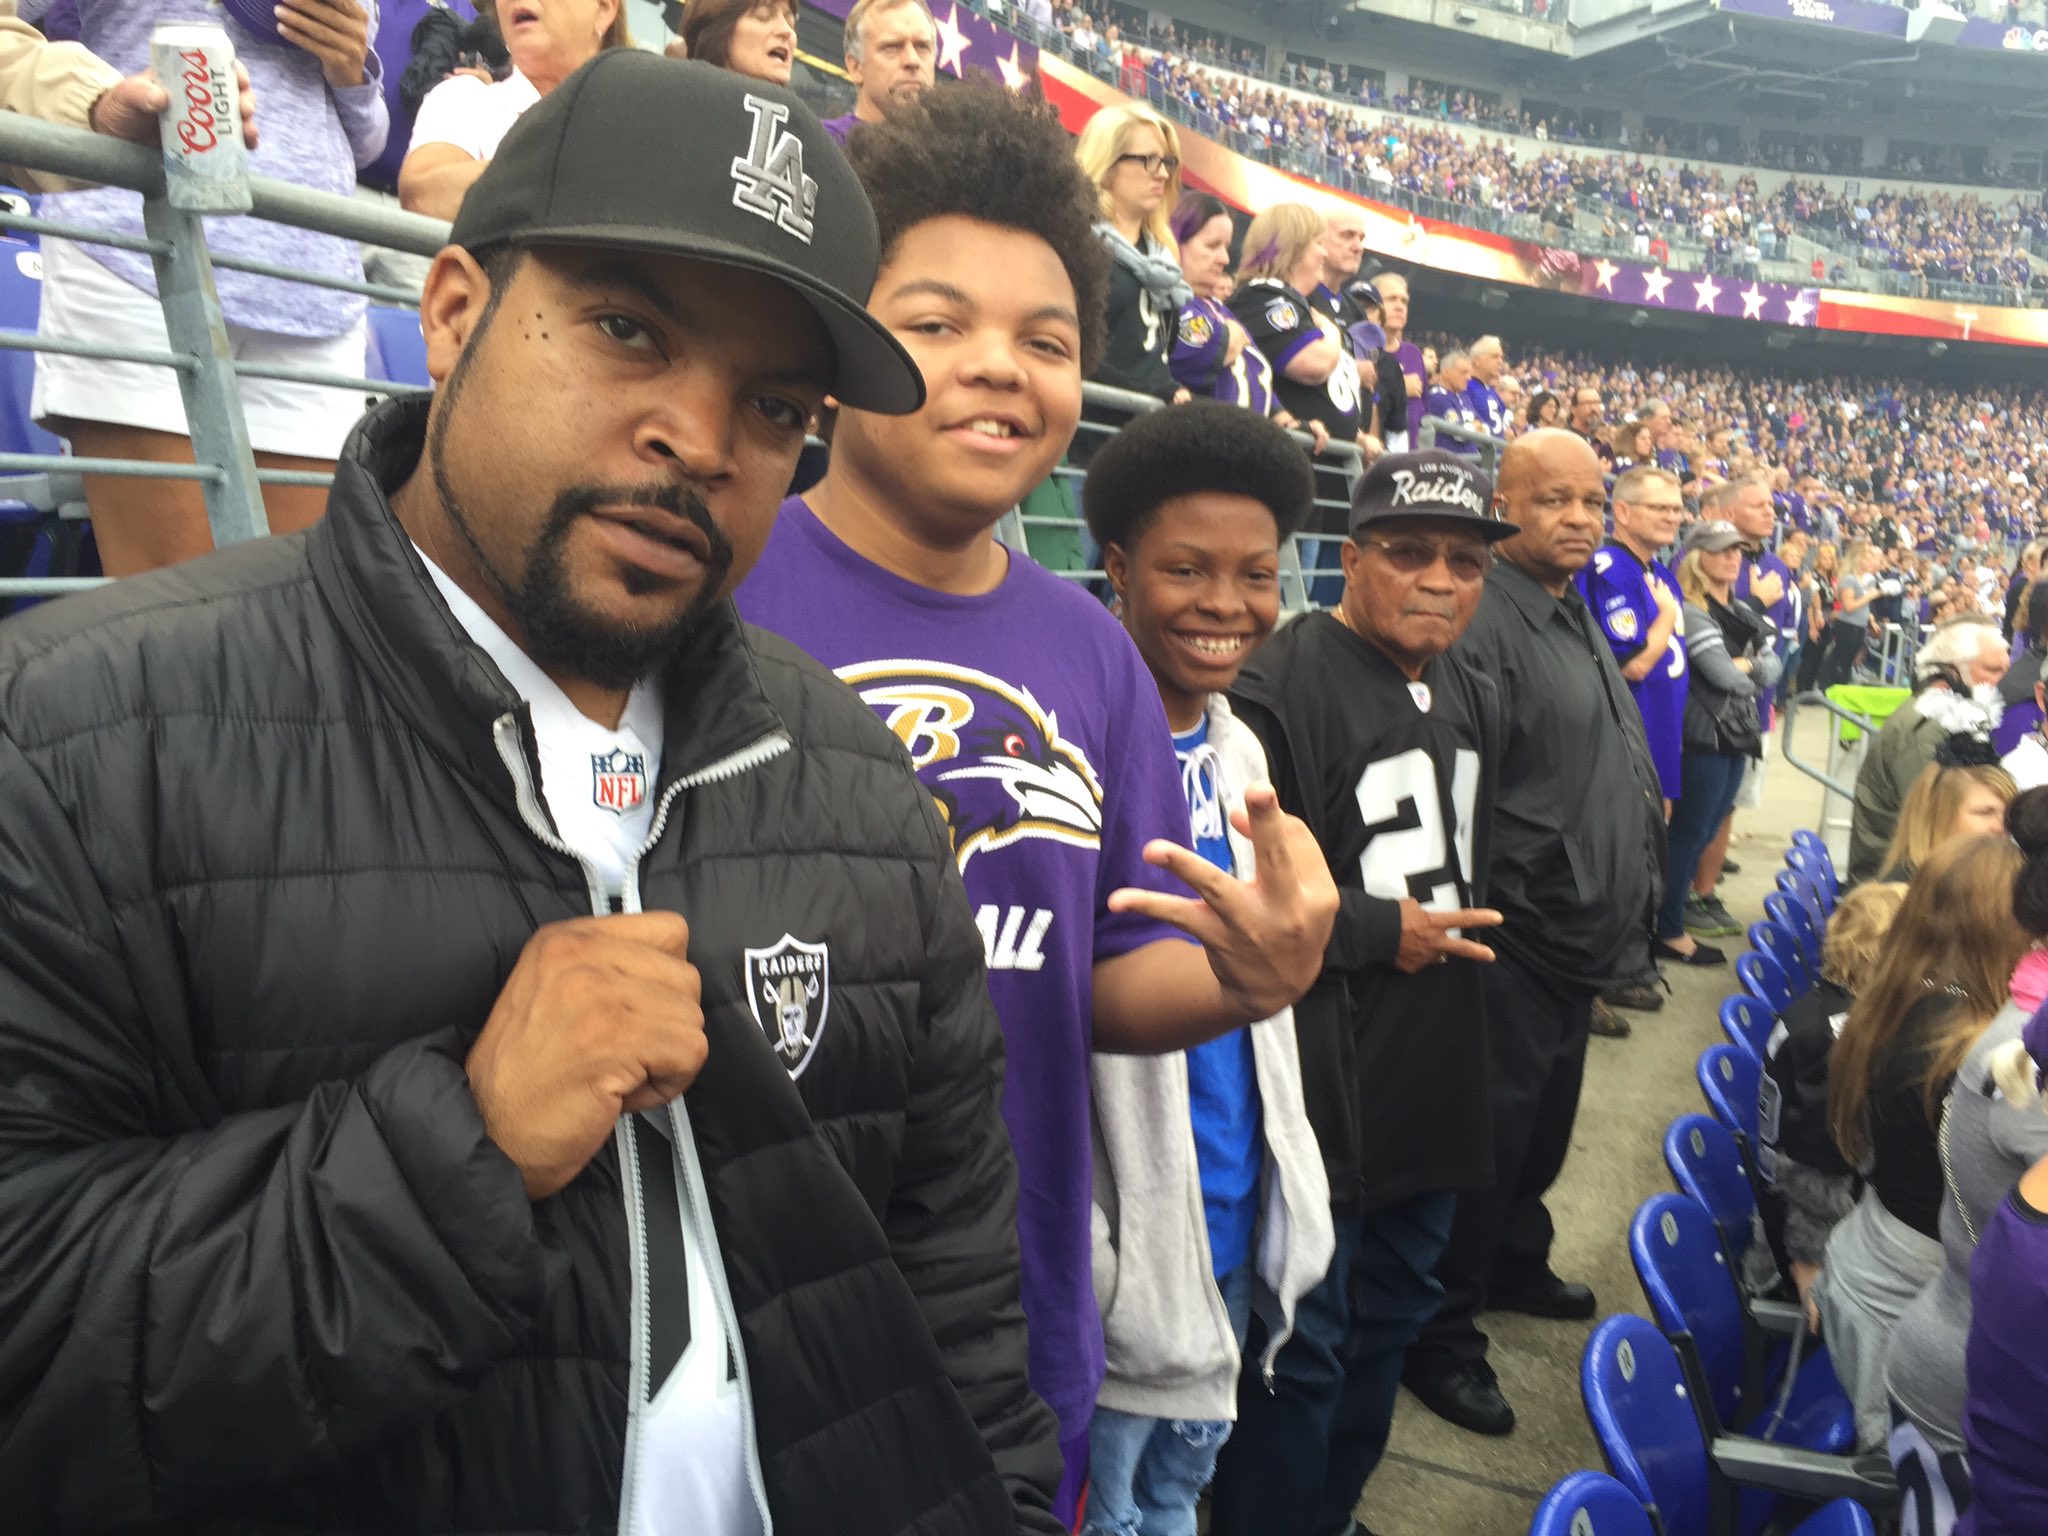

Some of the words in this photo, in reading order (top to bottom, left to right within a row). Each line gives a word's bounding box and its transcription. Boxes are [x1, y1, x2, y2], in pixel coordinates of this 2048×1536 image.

[177, 48, 218, 155] Coors
[210, 68, 234, 136] LIGHT
[730, 93, 819, 246] LA
[1419, 463, 1438, 473] LOS
[598, 774, 643, 808] NFL
[758, 953, 822, 977] RAIDERS
